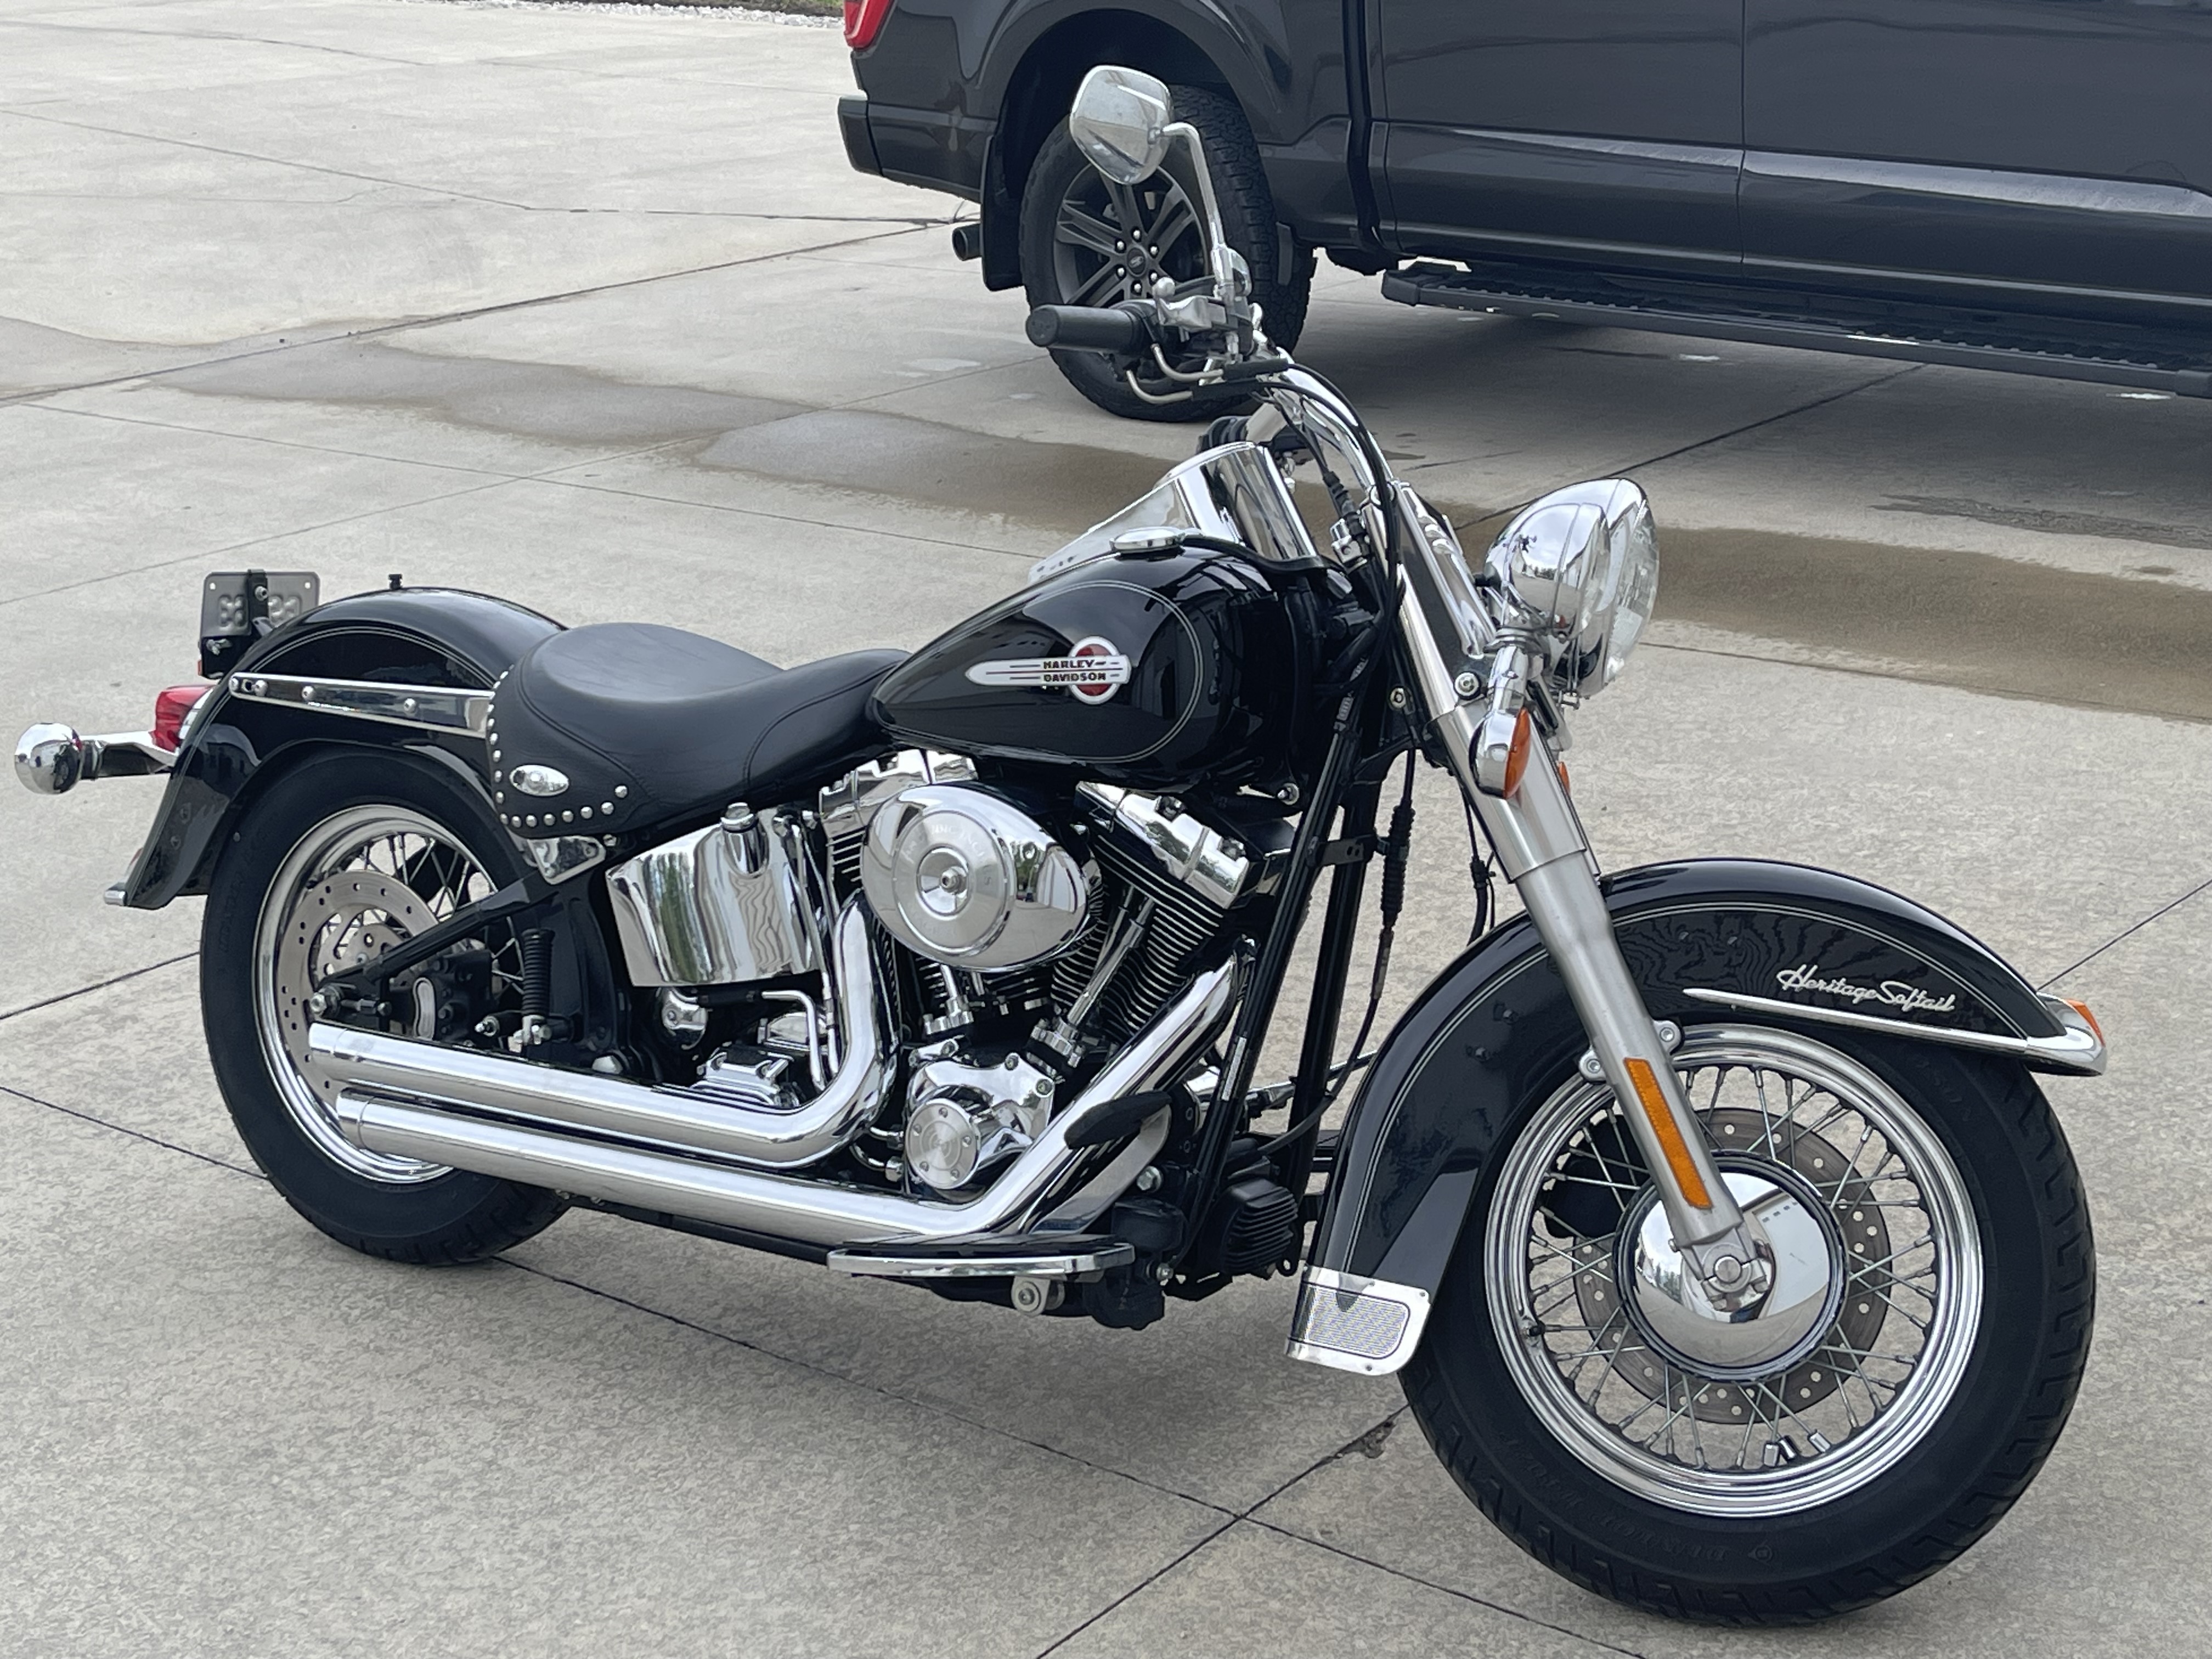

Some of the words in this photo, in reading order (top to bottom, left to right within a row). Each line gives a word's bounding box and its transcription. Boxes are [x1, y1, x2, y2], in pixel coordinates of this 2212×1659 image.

[1043, 672, 1107, 682] DAVIDSON
[1776, 963, 1877, 1005] Heritage
[1880, 980, 1956, 1013] Softail
